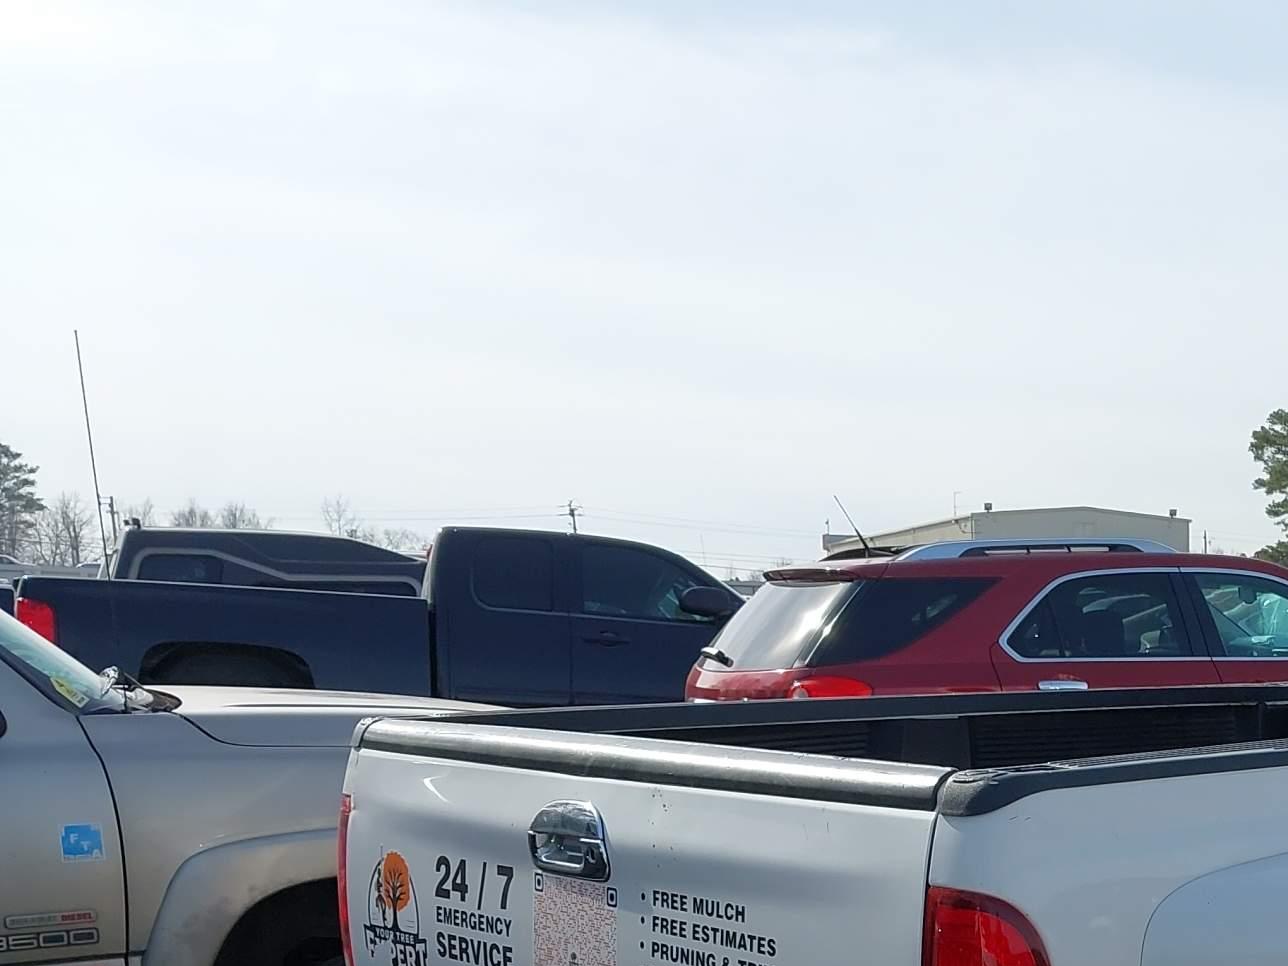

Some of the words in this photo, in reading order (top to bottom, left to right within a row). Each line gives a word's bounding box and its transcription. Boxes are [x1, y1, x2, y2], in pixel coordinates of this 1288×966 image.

[435, 905, 513, 938] EMERGENCY
[651, 889, 689, 913] FREE
[692, 897, 746, 923] MULCH
[395, 931, 416, 945] TREE
[651, 915, 688, 939] FREE
[691, 923, 777, 957] ESTIMATES
